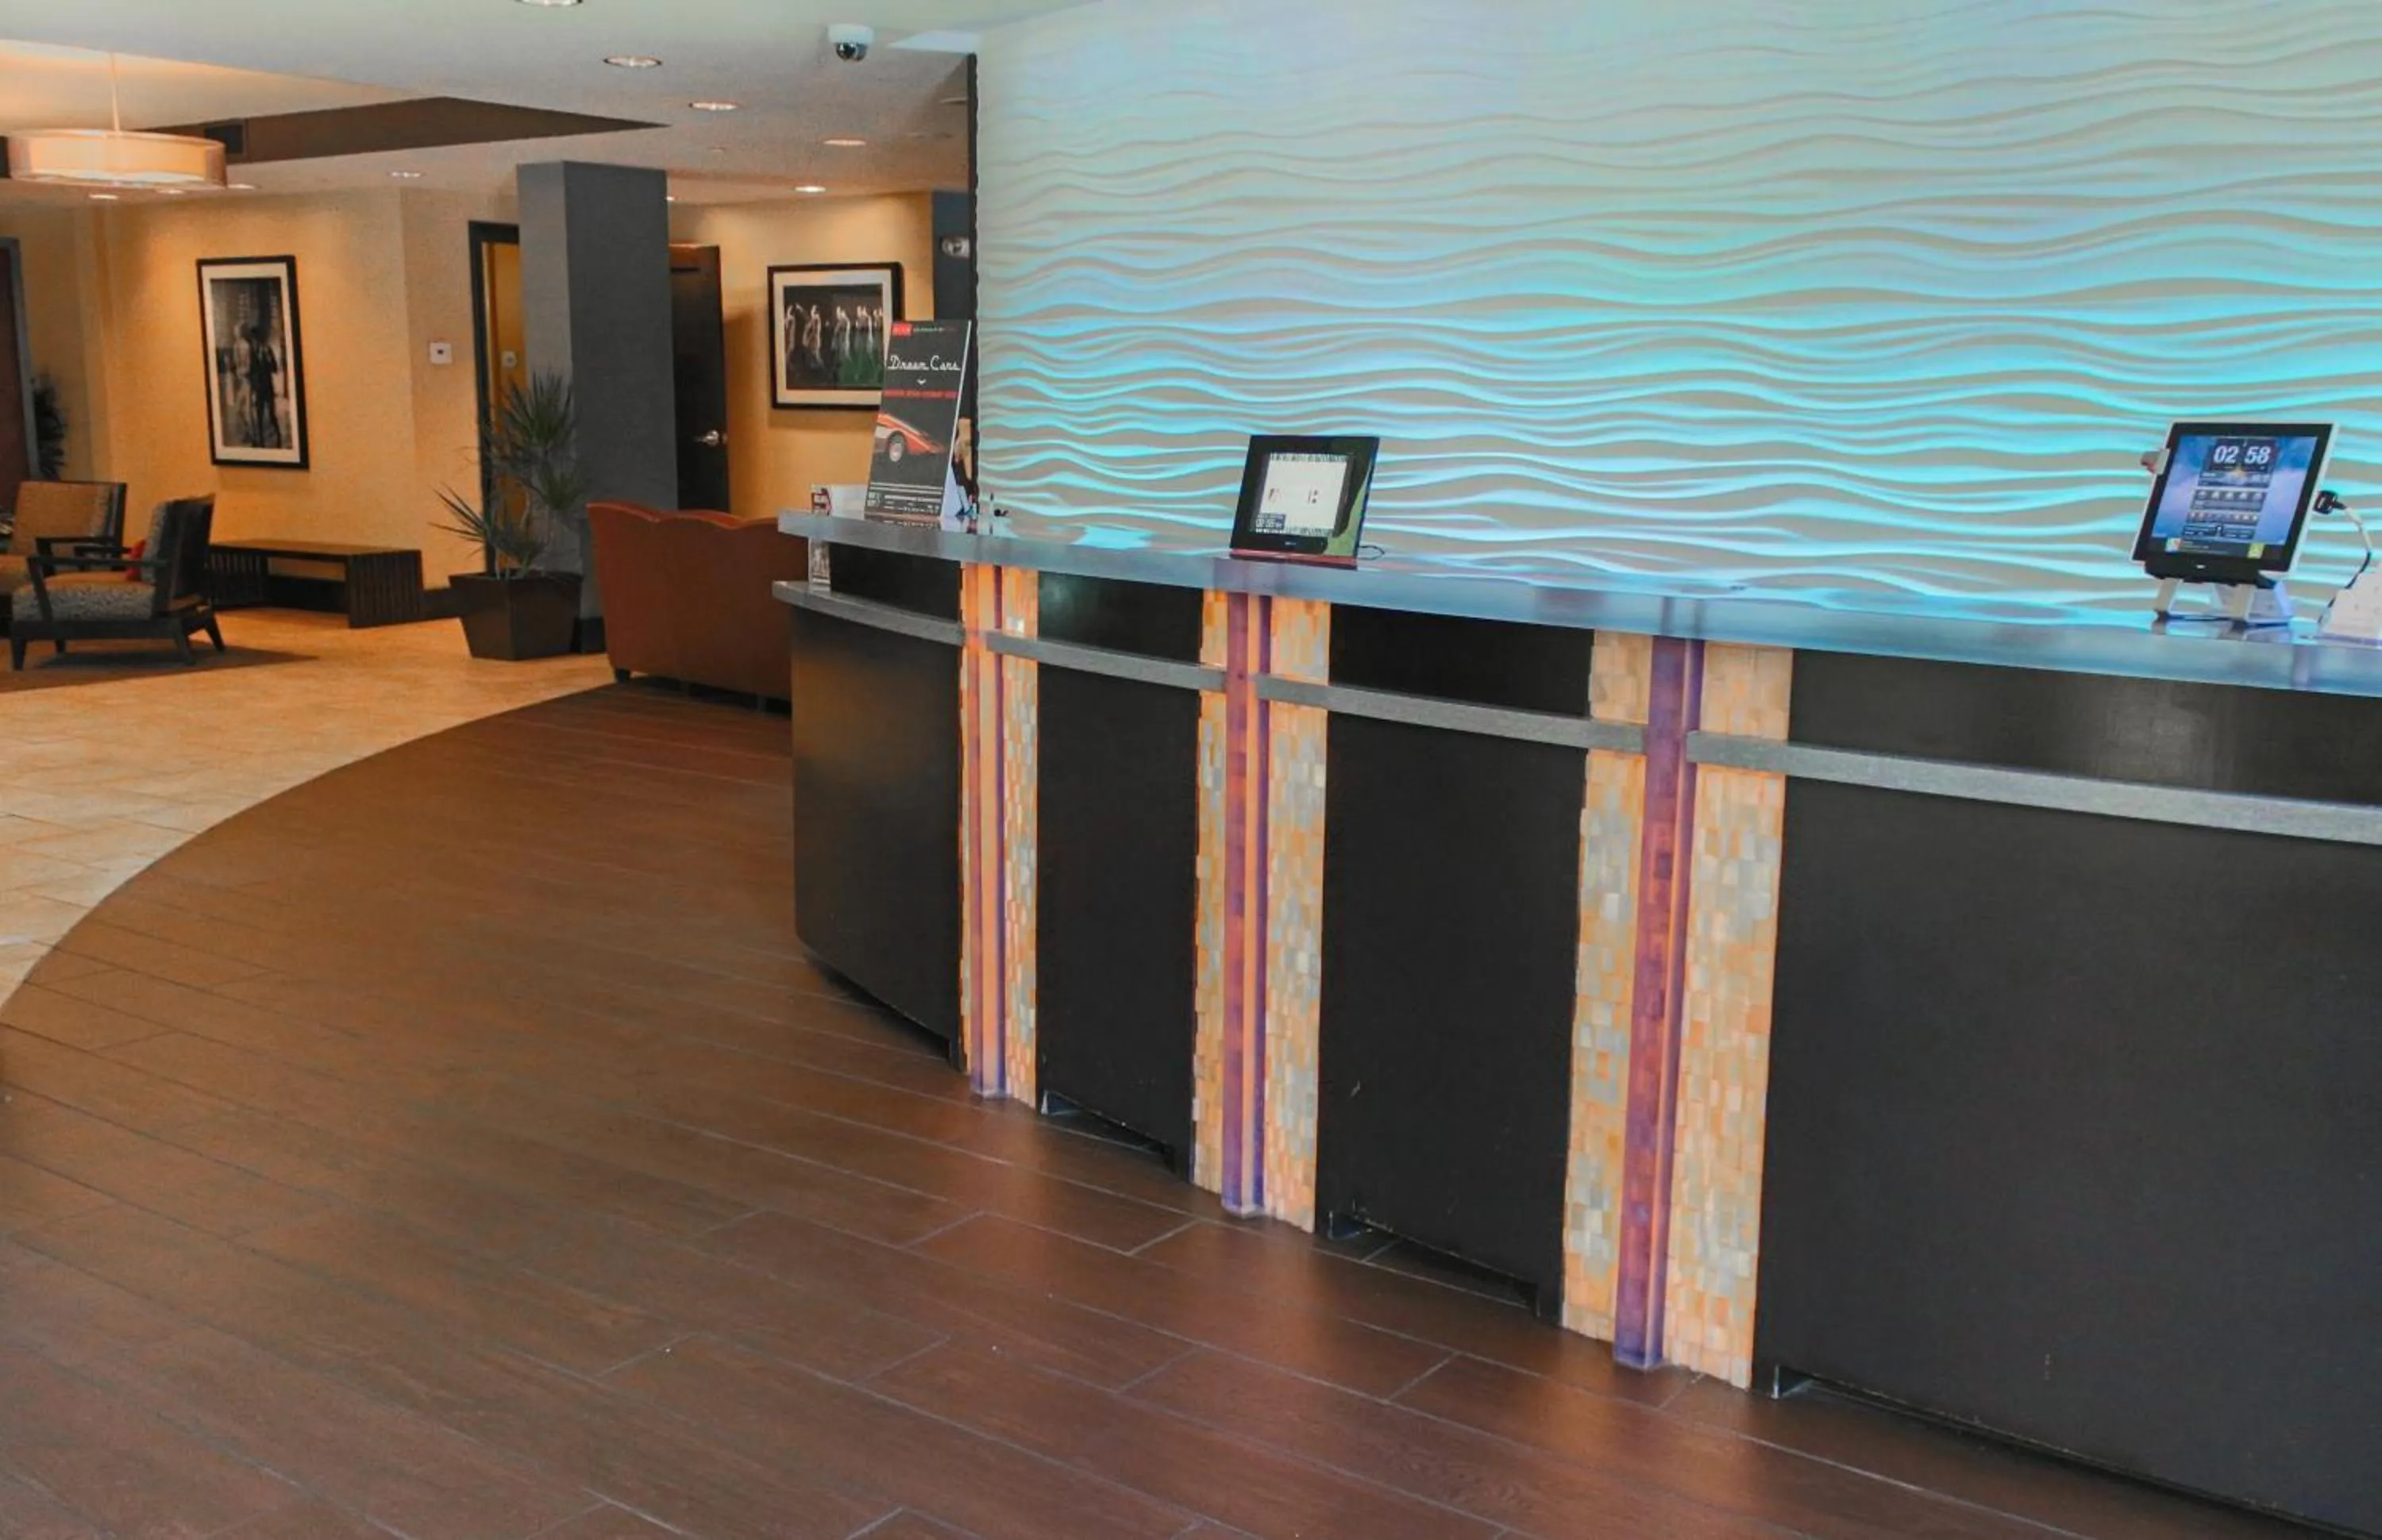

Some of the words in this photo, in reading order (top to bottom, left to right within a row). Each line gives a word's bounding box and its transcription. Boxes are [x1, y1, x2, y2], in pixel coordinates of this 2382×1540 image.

[888, 355, 929, 371] Dream
[930, 355, 961, 371] Cars
[2213, 445, 2239, 464] 02
[2244, 445, 2272, 464] 58
